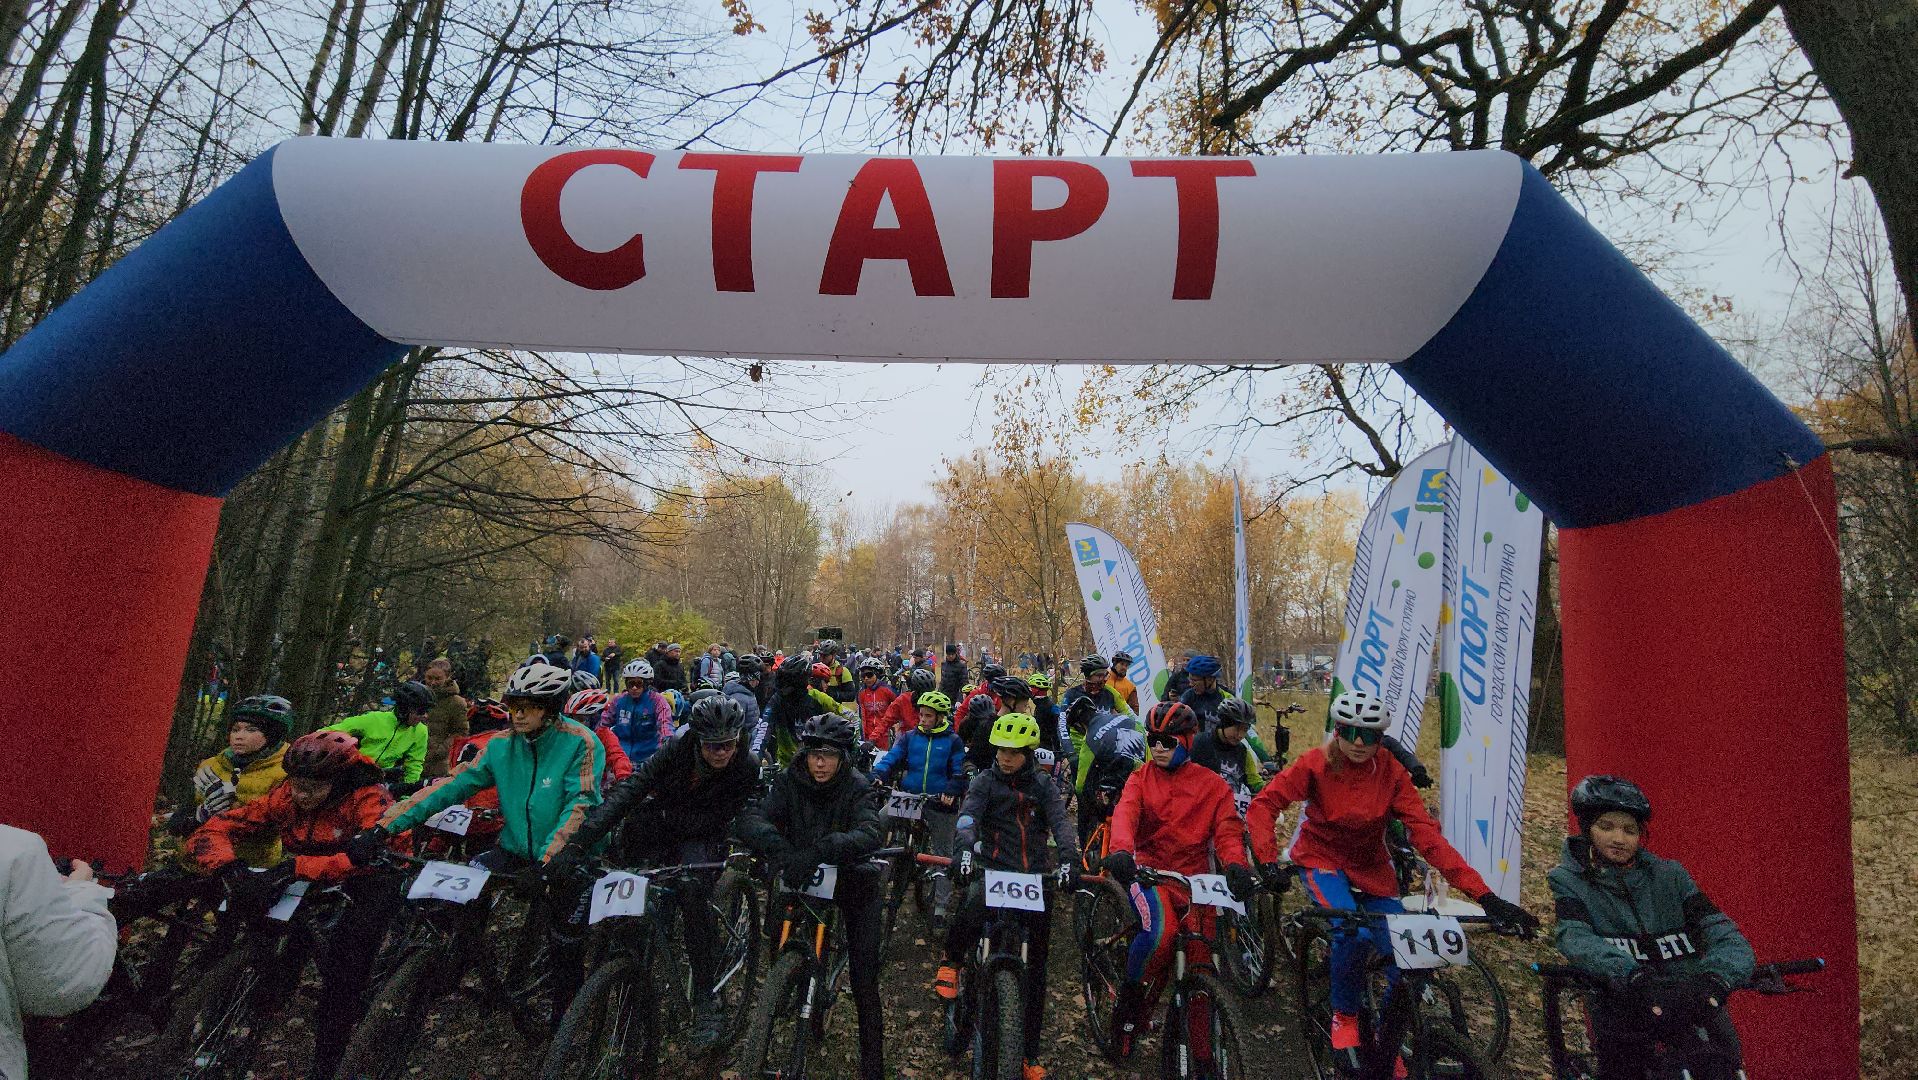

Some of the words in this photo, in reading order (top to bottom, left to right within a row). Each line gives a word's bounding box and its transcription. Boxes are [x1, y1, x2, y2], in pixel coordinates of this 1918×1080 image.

[520, 148, 1257, 301] СТАРТ
[1498, 543, 1516, 602] СТУПИНО
[1459, 565, 1490, 706] СПОРТ
[1494, 600, 1511, 643] ОКРУГ
[1384, 656, 1406, 714] ОРОДСКОЙ
[1402, 589, 1417, 632] СТУПИНО
[1490, 641, 1507, 725] ГОРОДСКОЙ
[444, 811, 469, 826] 57
[432, 872, 471, 891] 73
[603, 877, 635, 905] 70
[989, 880, 1040, 901] 466
[1399, 928, 1464, 956] 119
